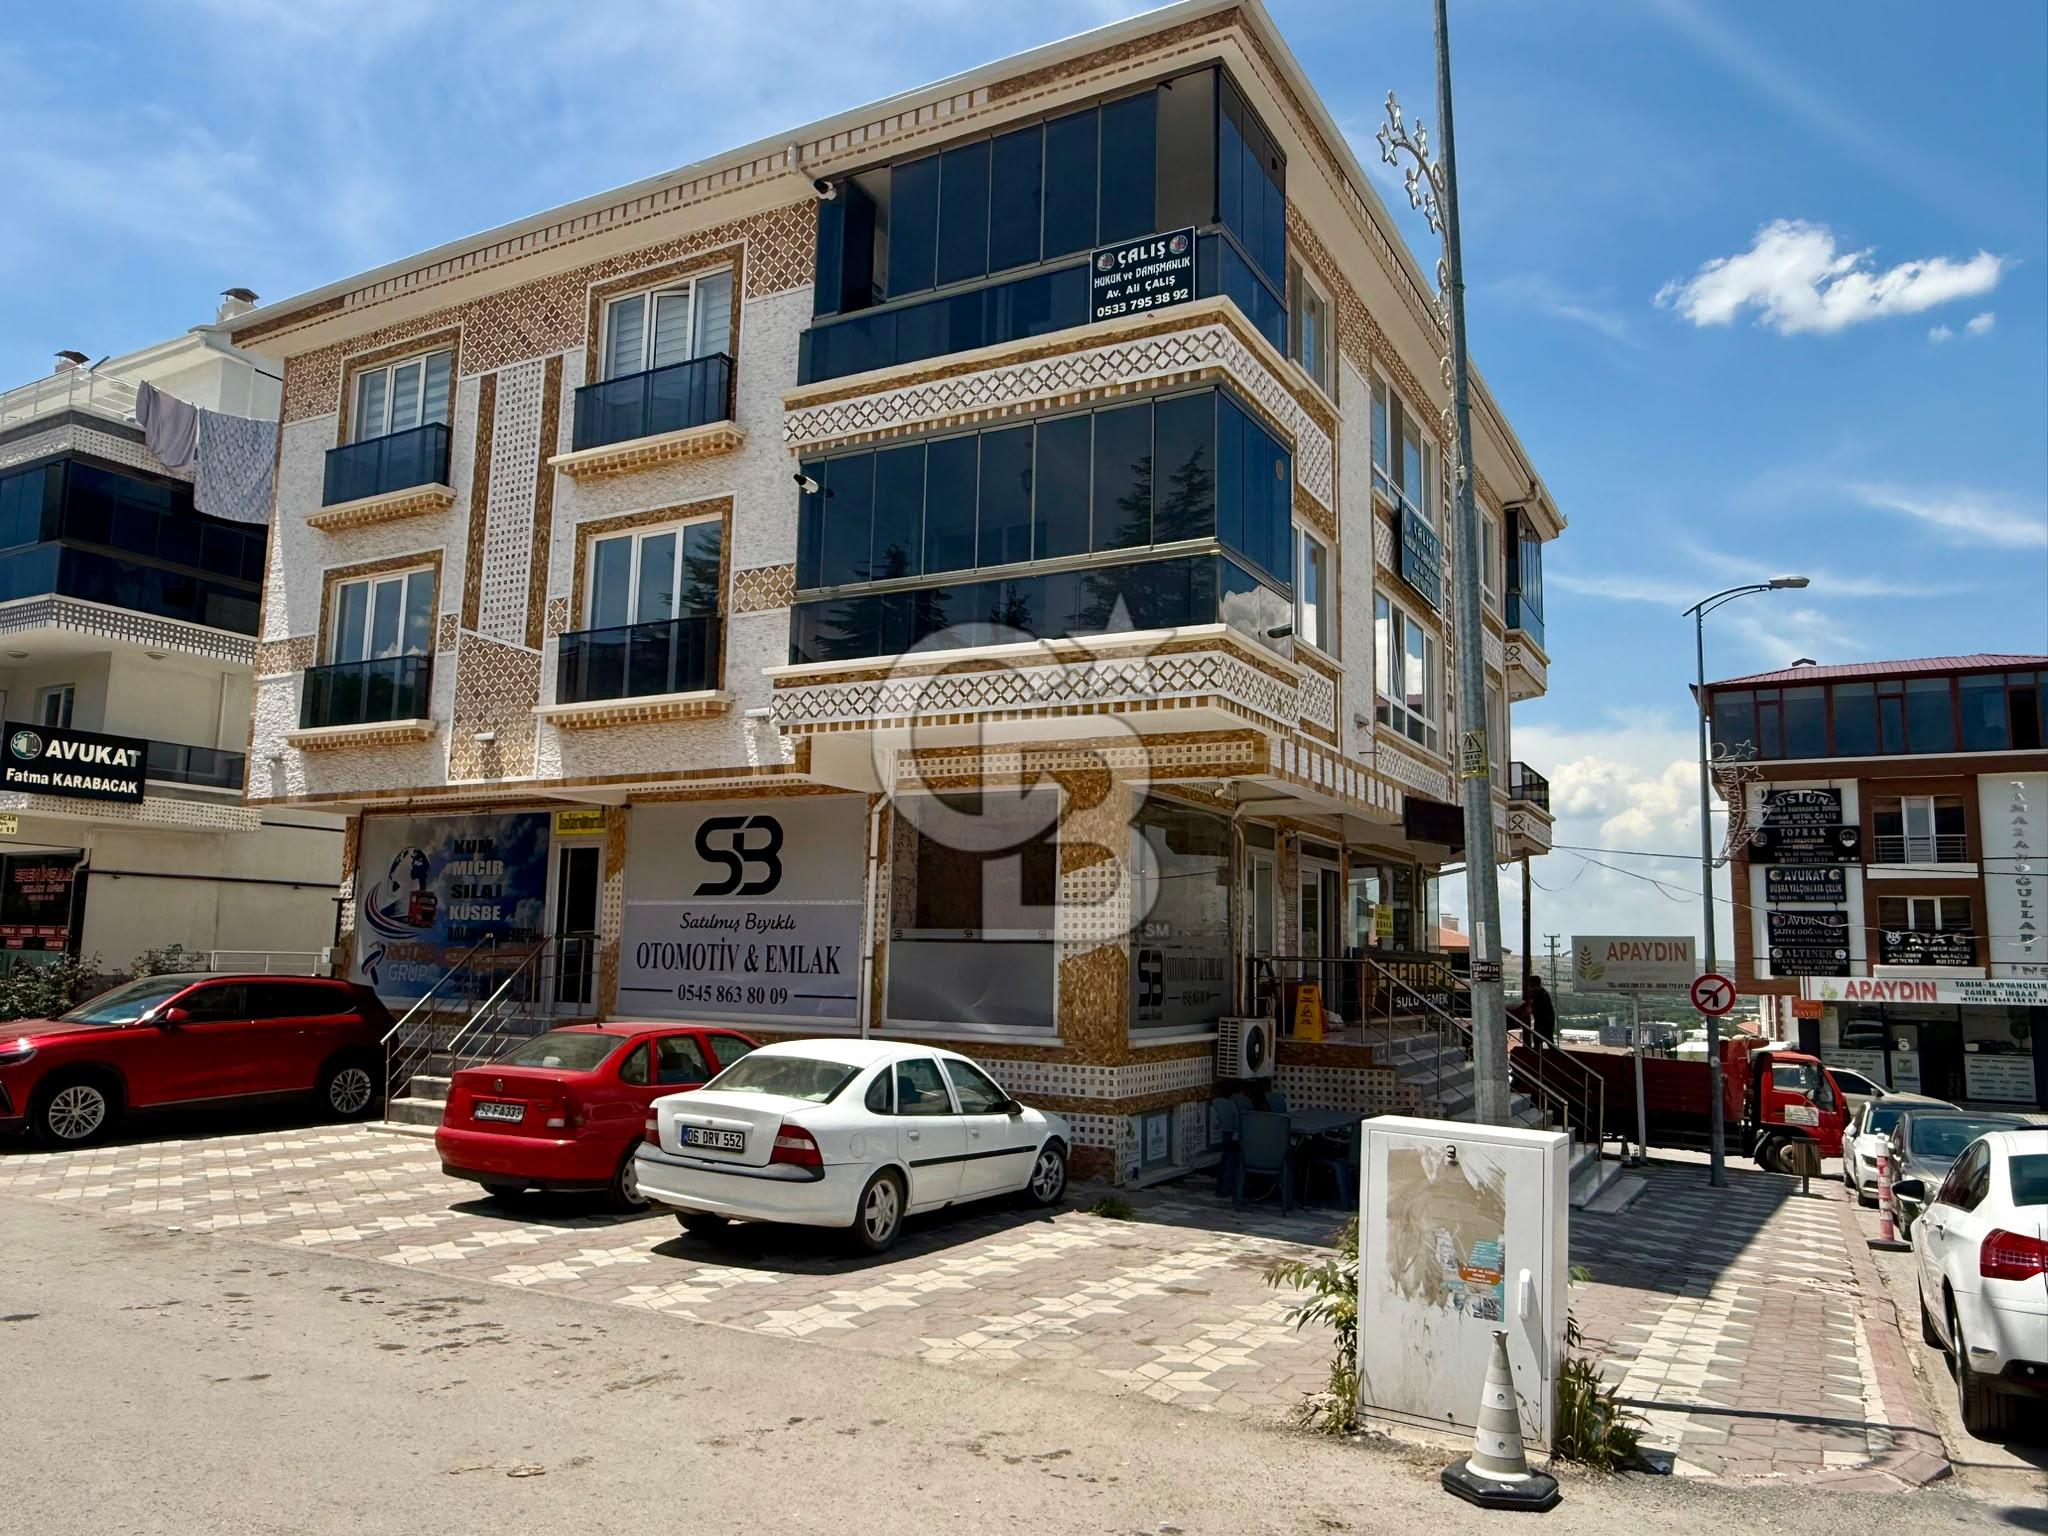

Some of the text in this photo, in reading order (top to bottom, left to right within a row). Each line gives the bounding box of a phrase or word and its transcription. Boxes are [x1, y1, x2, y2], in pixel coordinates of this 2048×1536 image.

[1118, 241, 1165, 268] ÇALIŞ
[1094, 256, 1190, 288] HUKUK ve DANIŞMANLIK
[1106, 275, 1175, 299] Av. Ali ÇALIŞ
[1097, 288, 1188, 317] 0533 795 38 92
[45, 739, 141, 768] AVUKAT
[6, 768, 138, 794] Fatma KARABACAK
[693, 815, 784, 897] SB
[1784, 869, 1827, 881] AVUKAT
[680, 912, 796, 934] Satılmış Bıyıklı
[636, 937, 840, 974] OTOMOTİV & EMLAK
[1606, 941, 1688, 962] APAYDIN
[678, 984, 788, 1004] 0545 863 80 09
[1845, 980, 1937, 1000] APAYDIN
[688, 1130, 741, 1147] 06 DRV 552
